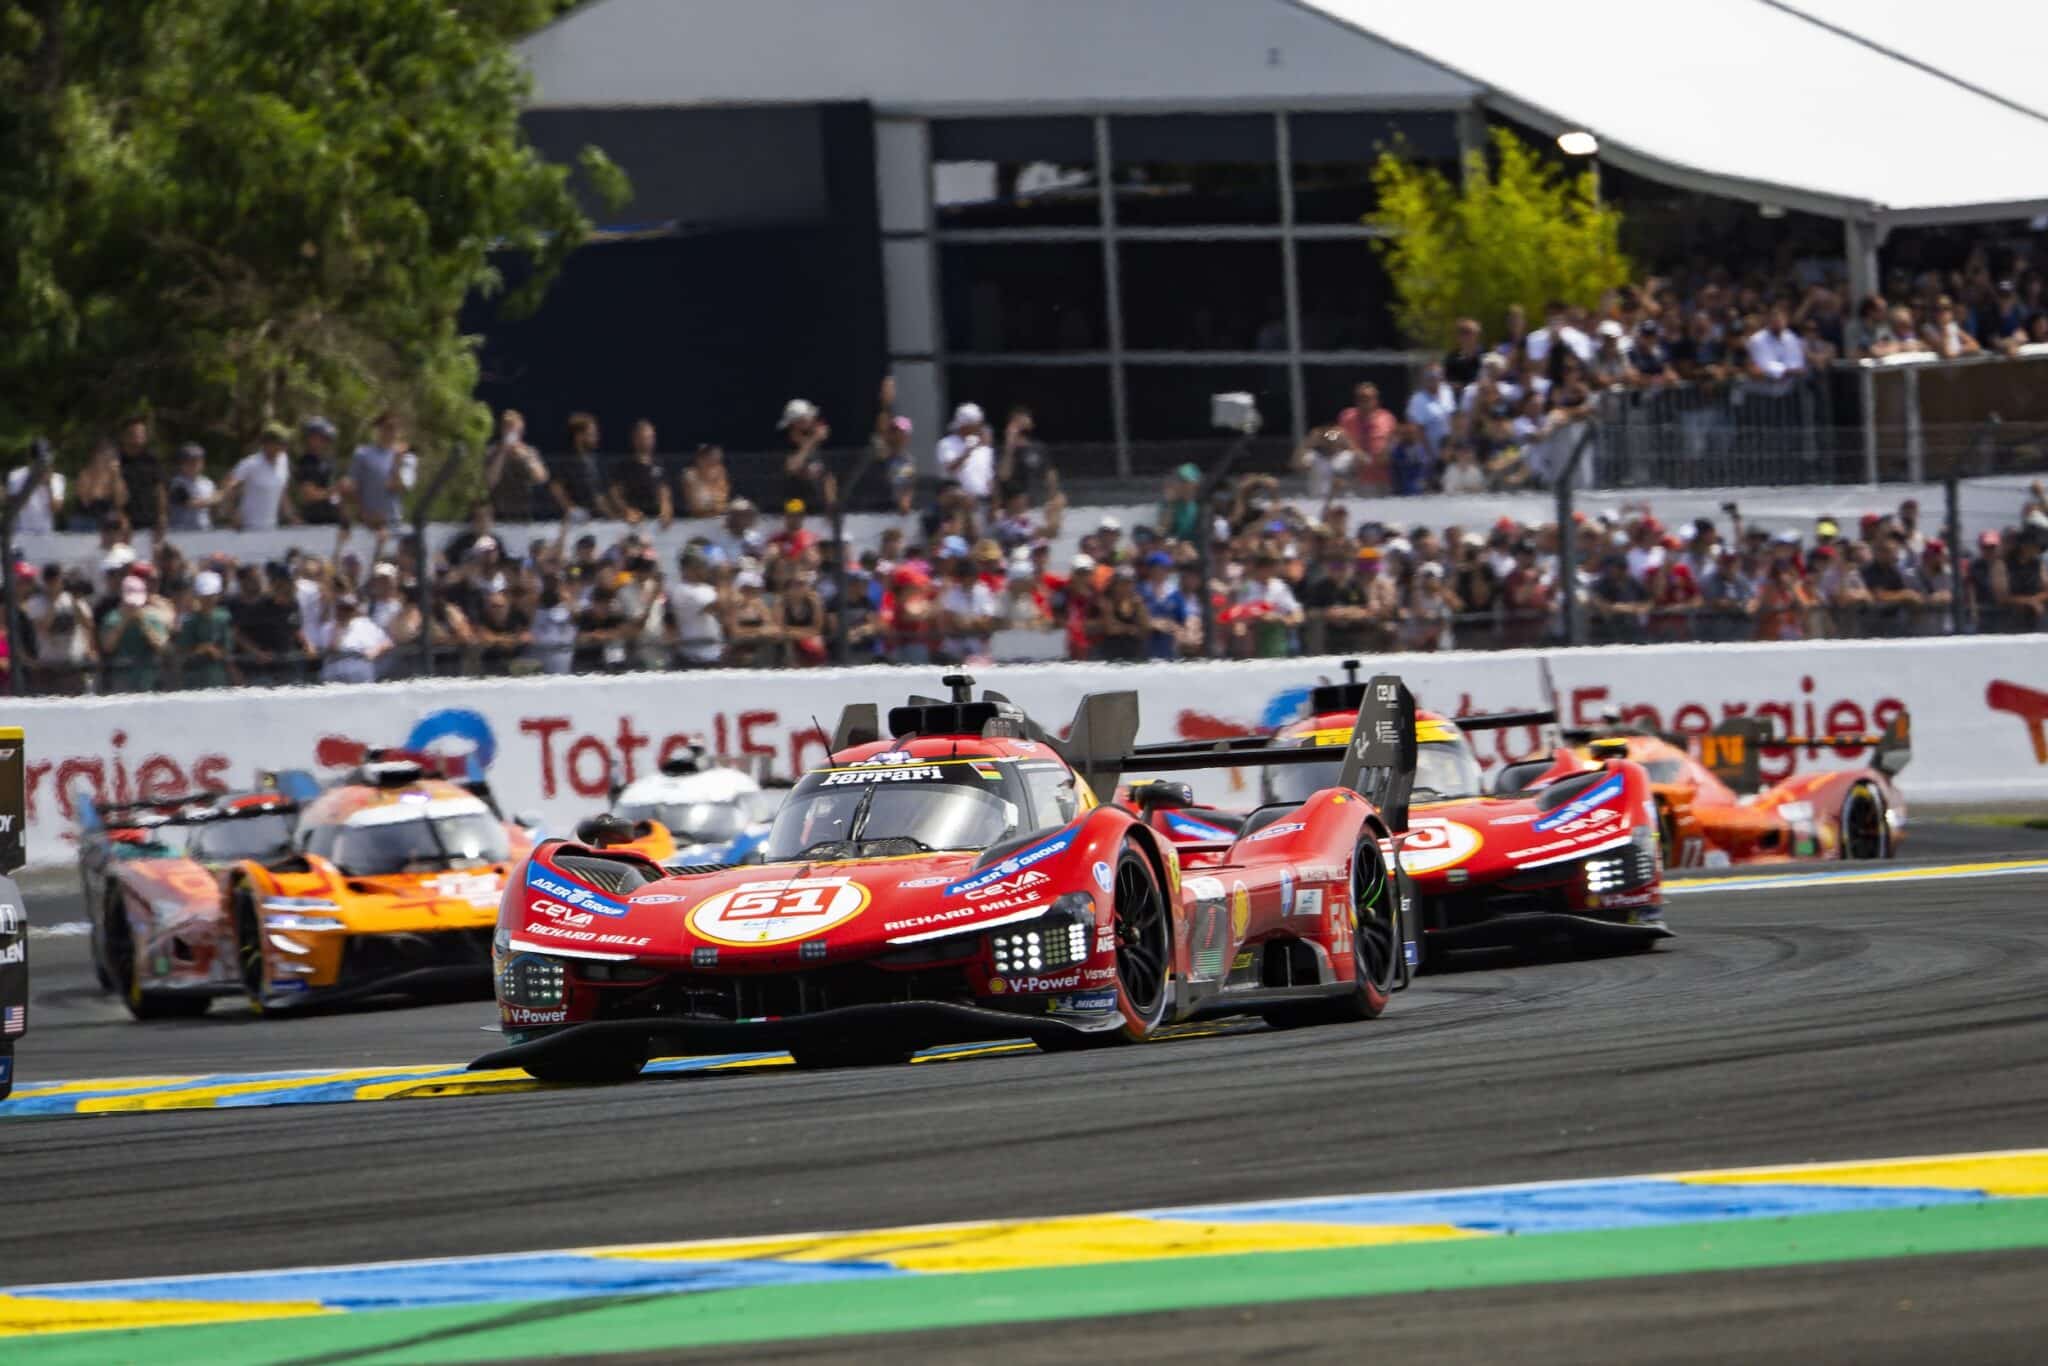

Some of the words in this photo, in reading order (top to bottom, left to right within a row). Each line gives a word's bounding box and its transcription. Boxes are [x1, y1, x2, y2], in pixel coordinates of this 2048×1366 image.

[819, 765, 944, 786] Ferrari
[952, 872, 1003, 893] ADLER
[1019, 841, 1067, 865] GROUP
[531, 878, 569, 898] ADLER
[583, 901, 625, 915] GROUP
[726, 889, 826, 918] 51
[884, 906, 975, 931] RICHARD
[979, 890, 1041, 913] MILLE
[526, 922, 596, 941] RICHARD
[597, 933, 651, 946] MILLE
[1010, 976, 1080, 993] V-Power
[511, 1008, 567, 1023] V-Power
